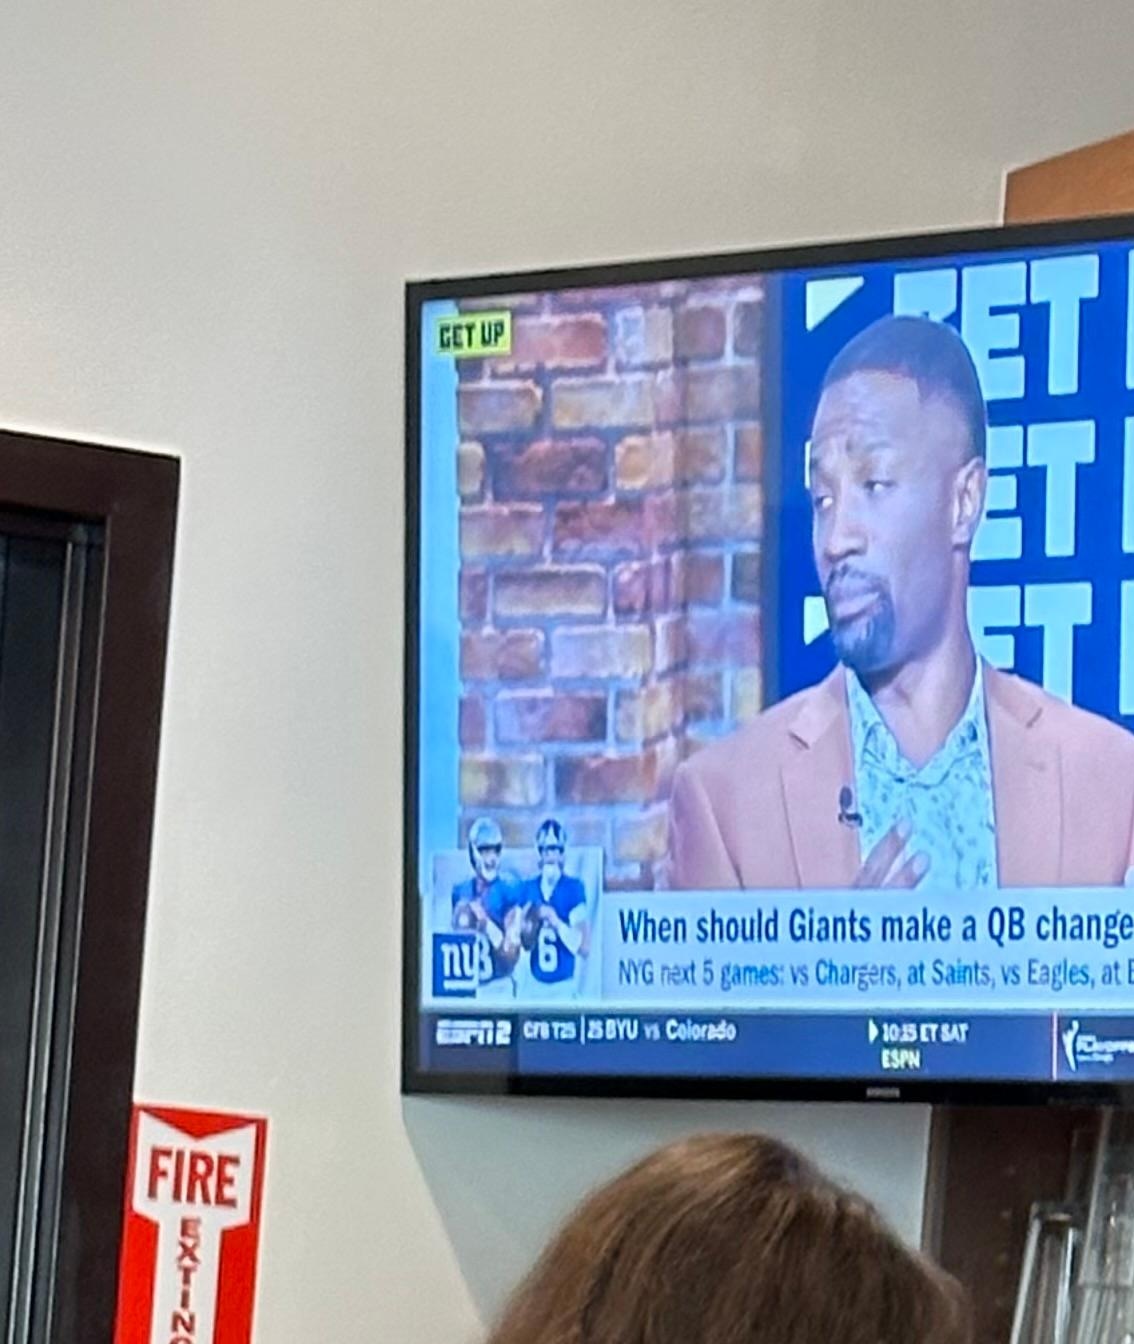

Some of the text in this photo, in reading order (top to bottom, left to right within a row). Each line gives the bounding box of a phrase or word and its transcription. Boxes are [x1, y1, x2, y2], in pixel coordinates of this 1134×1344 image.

[439, 320, 504, 348] GET UP
[970, 419, 1097, 561] ET
[619, 909, 687, 944] When
[696, 907, 778, 943] should
[789, 907, 872, 942] Giants
[881, 906, 951, 942] make
[962, 915, 977, 941] a
[988, 906, 1025, 947] QB
[538, 924, 558, 973] 6
[619, 959, 654, 986] NYG
[661, 960, 696, 985] next
[703, 959, 714, 985] 5
[720, 962, 785, 991] games:
[790, 964, 809, 985] vs
[815, 958, 901, 992] Chargers,
[907, 961, 926, 985] at
[932, 958, 996, 990] Saints,
[1001, 964, 1021, 985] vs
[1027, 958, 1095, 992] Eagles,
[1101, 961, 1121, 985] at
[605, 1019, 639, 1040] BYU
[665, 1018, 737, 1041] Colorado
[920, 1023, 938, 1042] ET
[941, 1023, 969, 1042] SAT
[881, 1048, 921, 1070] ESPN
[147, 1145, 240, 1209] FIRE
